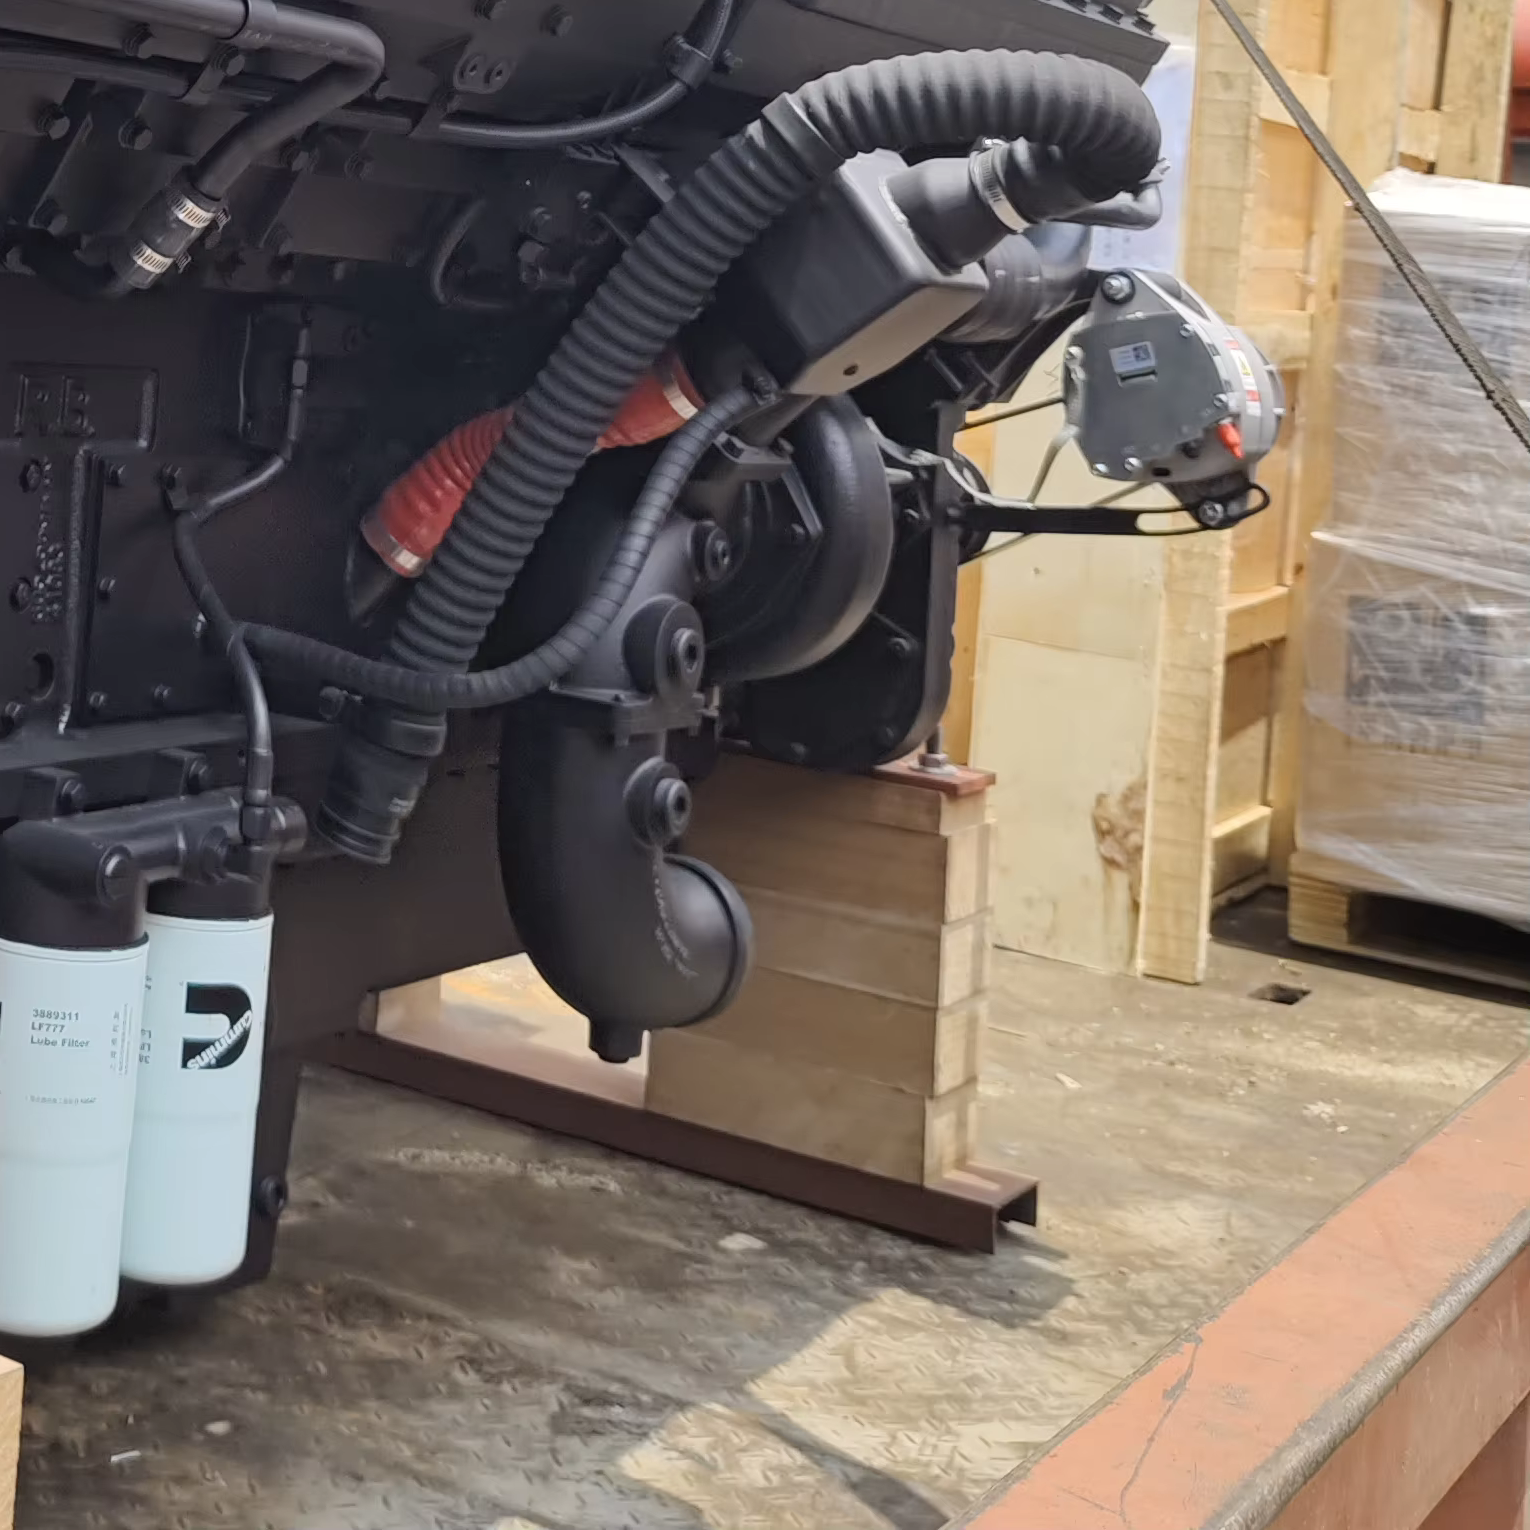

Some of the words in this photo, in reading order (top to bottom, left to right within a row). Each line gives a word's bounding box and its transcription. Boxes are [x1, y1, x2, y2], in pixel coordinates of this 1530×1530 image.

[31, 1021, 66, 1033] LF777
[30, 1034, 58, 1046] Lube
[61, 1036, 90, 1048] Filter
[187, 1010, 253, 1070] Cummins
